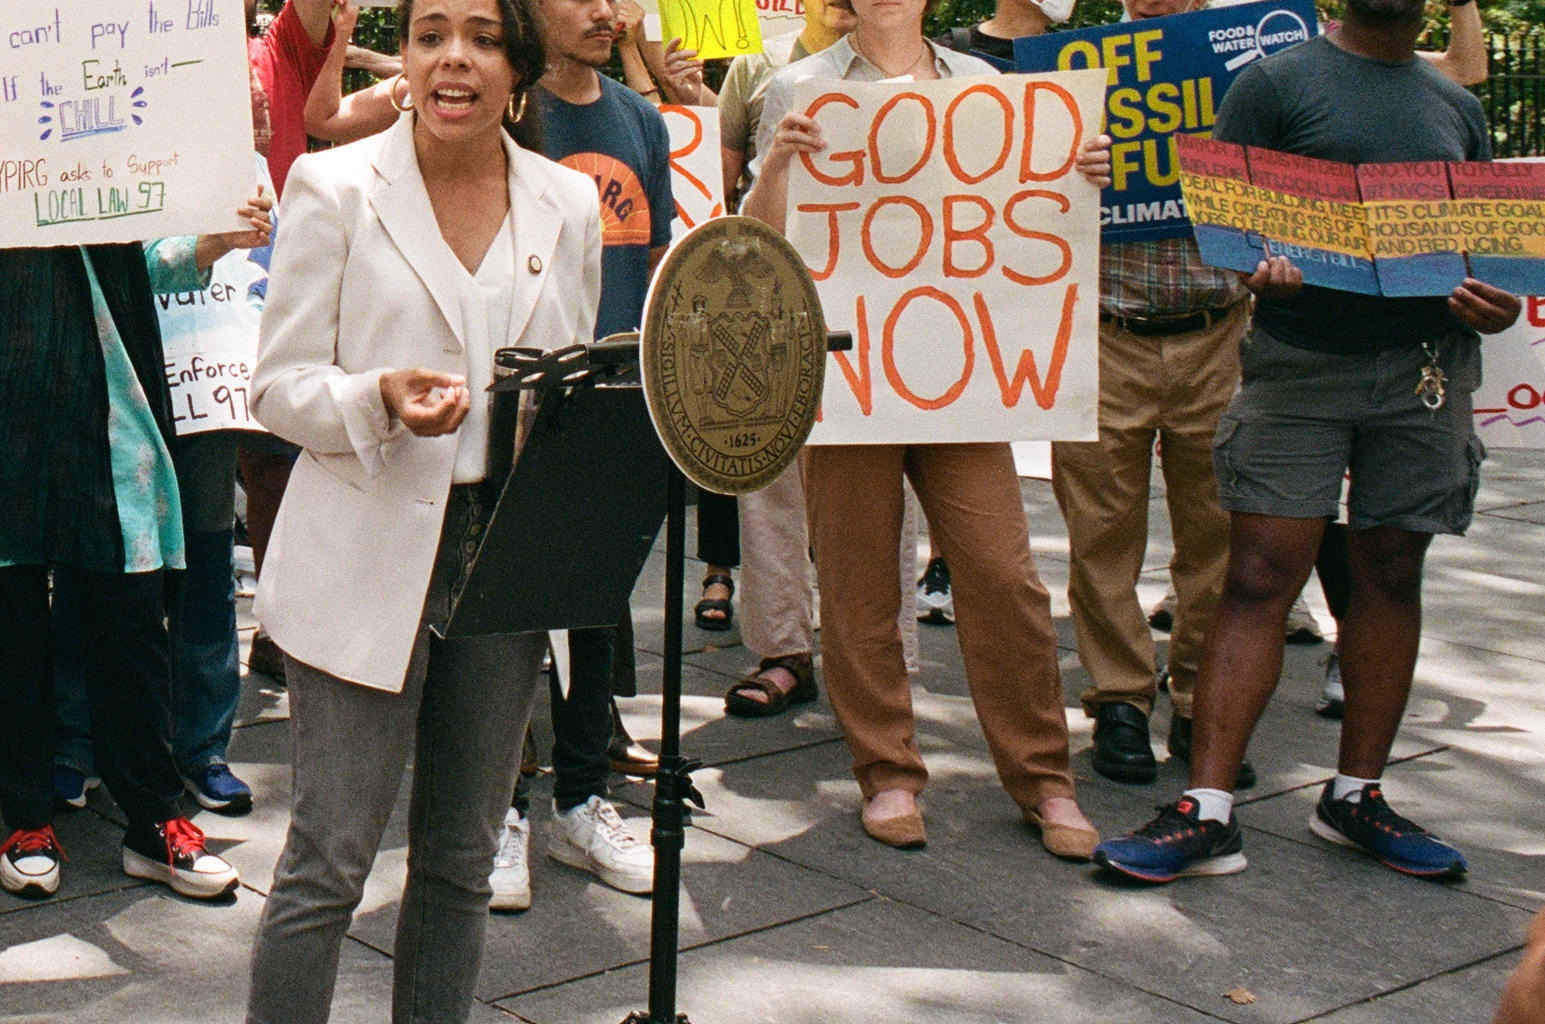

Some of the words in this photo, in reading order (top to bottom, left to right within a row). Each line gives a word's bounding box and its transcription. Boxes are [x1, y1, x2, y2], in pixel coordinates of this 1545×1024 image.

[9, 8, 60, 49] can't
[91, 21, 129, 49] pay
[148, 1, 174, 34] the
[1212, 38, 1255, 53] WATER
[1259, 29, 1303, 45] WATCH
[3, 76, 17, 101] If
[41, 72, 63, 96] the
[83, 60, 127, 90] Earth
[145, 57, 168, 77] isn't
[1058, 29, 1163, 86] OFF
[59, 95, 124, 135] CHILL
[1102, 77, 1216, 139] SSIL
[798, 81, 1083, 187] GOOD
[103, 159, 113, 177] to
[34, 187, 88, 224] LOCAL
[97, 187, 129, 213] LAW
[138, 182, 165, 209] 97
[1413, 203, 1492, 218] CLIMATE
[797, 189, 1072, 286] JOBS
[165, 357, 250, 387] Enforce
[816, 283, 1078, 423] NOW
[213, 386, 250, 422] 97
